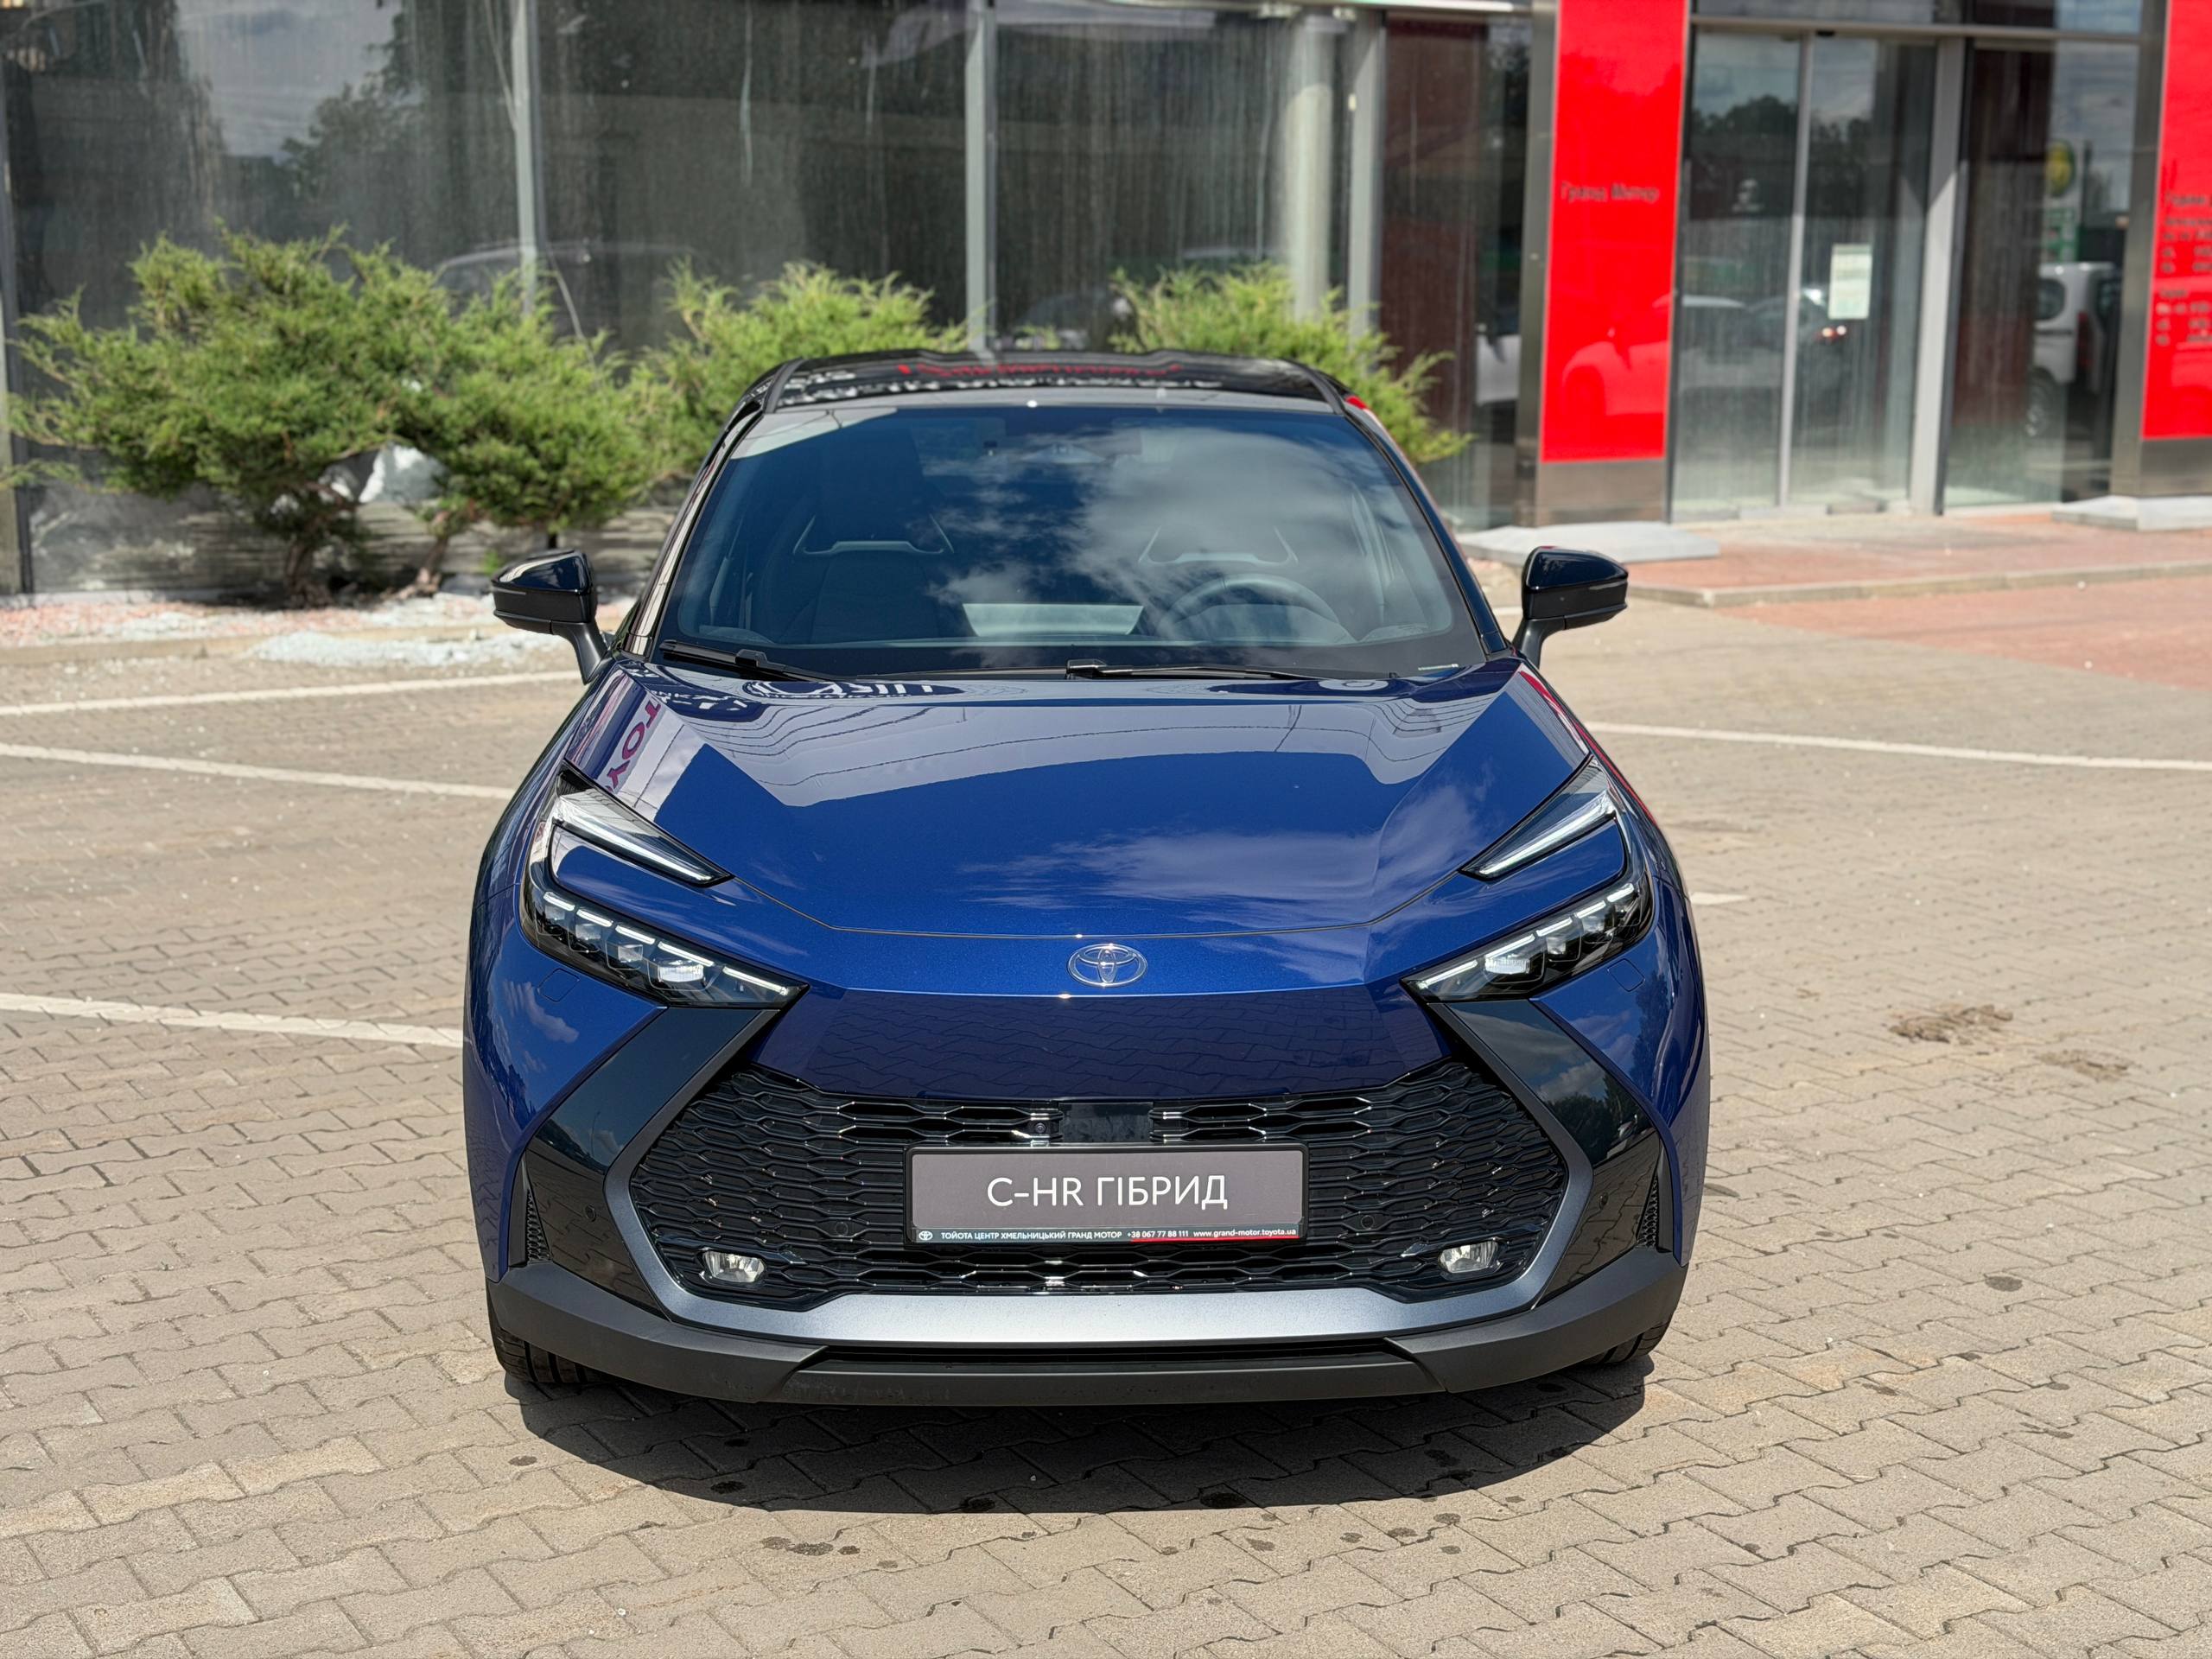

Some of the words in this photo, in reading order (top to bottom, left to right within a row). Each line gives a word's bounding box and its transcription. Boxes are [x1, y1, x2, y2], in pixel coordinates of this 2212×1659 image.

[1097, 1174, 1229, 1211] ГІБРИД
[941, 1231, 973, 1240] ТОЙОТА
[975, 1232, 1000, 1241] ЦЕНТР
[1001, 1231, 1066, 1241] ХМЕЛЬНИЦЬКИЙ
[1067, 1231, 1093, 1240] ГРАНД
[1093, 1230, 1122, 1239] МОТОР
[1192, 1228, 1297, 1238] www.grand-motor.toyota.ua
